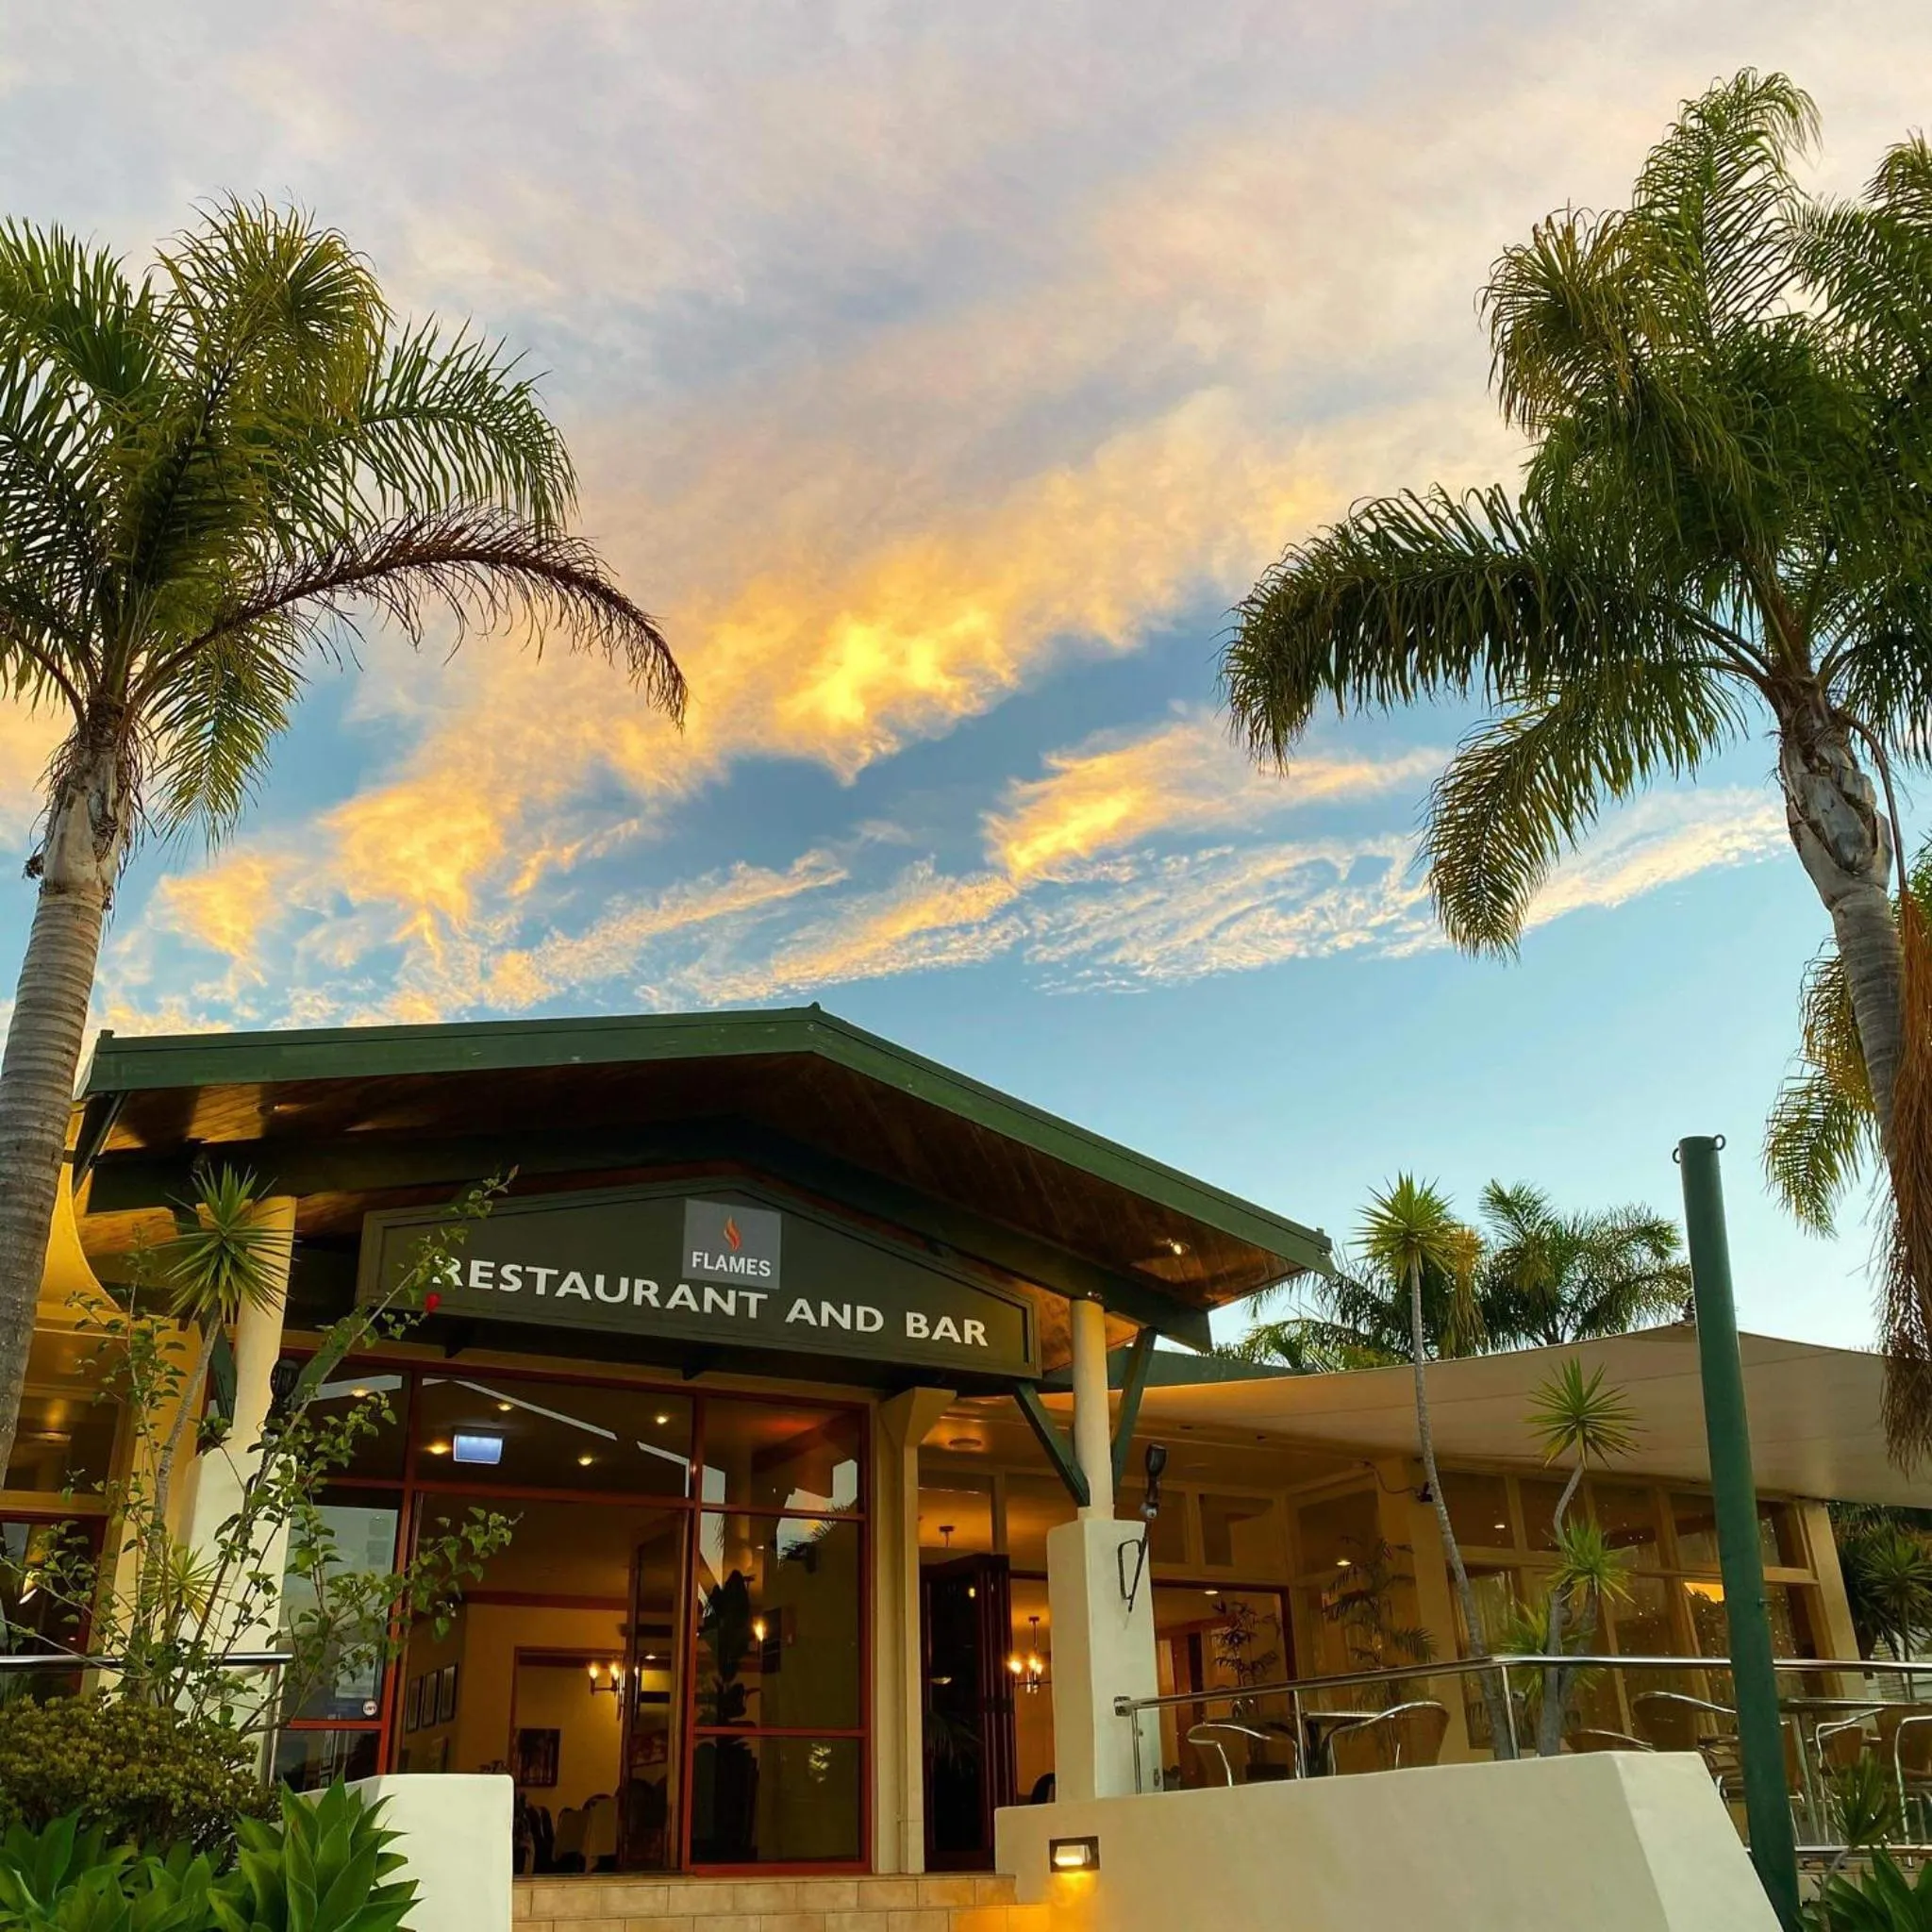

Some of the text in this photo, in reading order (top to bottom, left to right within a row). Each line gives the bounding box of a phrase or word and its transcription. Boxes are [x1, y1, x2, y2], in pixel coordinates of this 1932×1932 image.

[691, 1251, 772, 1277] FLAMES
[431, 1255, 989, 1347] RESTAURANT AND BAR
